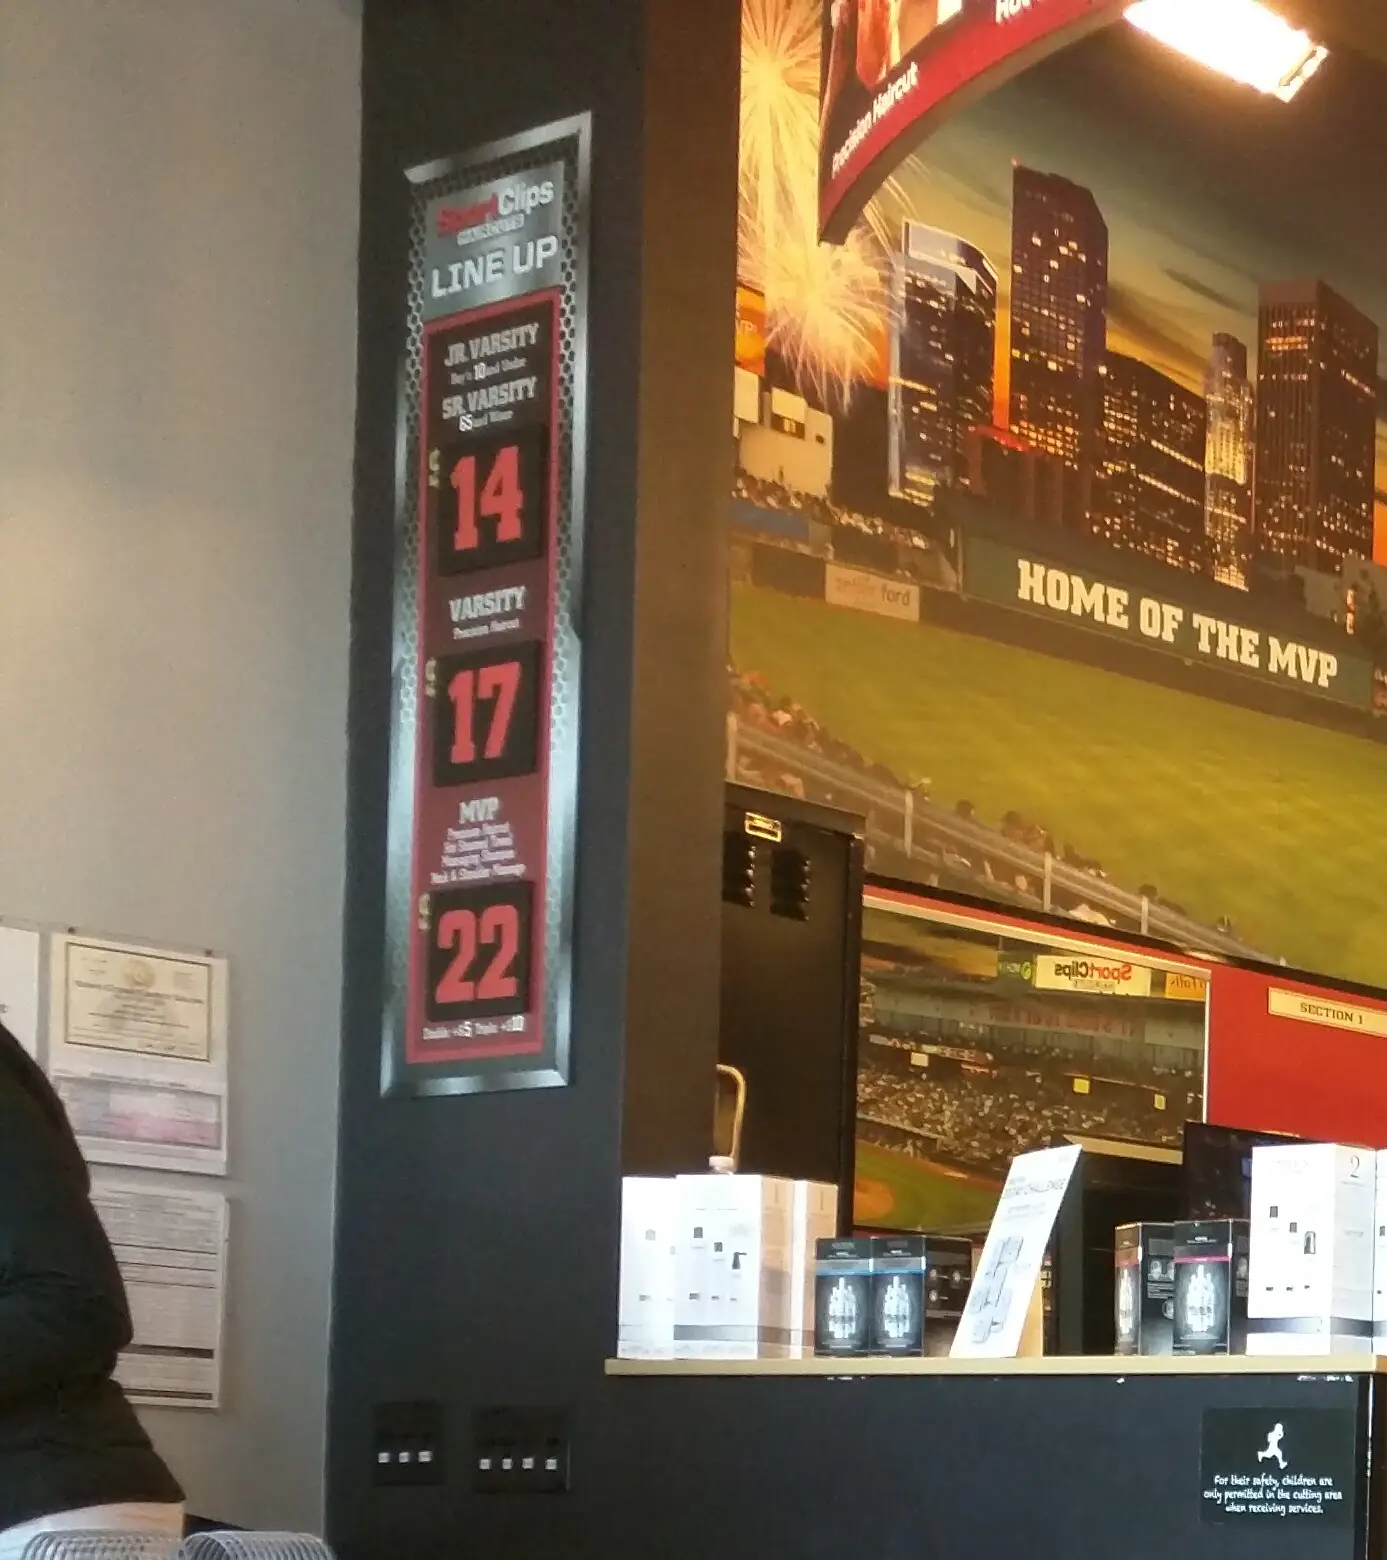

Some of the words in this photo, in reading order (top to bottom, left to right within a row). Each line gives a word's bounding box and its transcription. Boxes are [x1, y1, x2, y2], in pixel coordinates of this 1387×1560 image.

[873, 61, 918, 124] Haircut
[431, 250, 504, 299] LINE
[512, 235, 559, 275] UP
[444, 343, 468, 367] JR
[469, 322, 540, 360] VARSITY
[442, 395, 465, 419] SR
[467, 377, 538, 412] VARSITY
[450, 445, 524, 551] 14
[448, 586, 526, 622] VARSITY
[1017, 558, 1129, 630] HOME
[1139, 597, 1183, 643] OF
[1193, 612, 1260, 668] THE
[1268, 636, 1338, 687] MVP
[448, 661, 521, 764] 17
[458, 797, 499, 823] MVP
[435, 904, 519, 1005] 22
[1300, 1002, 1354, 1023] SECTION
[1350, 1155, 1361, 1179] 2
[1204, 1489, 1222, 1504] only
[1224, 1489, 1264, 1504] permitted
[1266, 1487, 1275, 1499] in
[1277, 1488, 1290, 1499] the
[1293, 1489, 1322, 1503] cutting
[1324, 1491, 1343, 1500] area
[1214, 1475, 1229, 1486] For
[1231, 1474, 1250, 1486] their
[1252, 1473, 1279, 1490] safety,
[1282, 1474, 1317, 1486] children
[1319, 1477, 1333, 1486] are
[1225, 1504, 1247, 1512] when
[1249, 1504, 1286, 1516] receiving
[1289, 1504, 1324, 1514] services.
